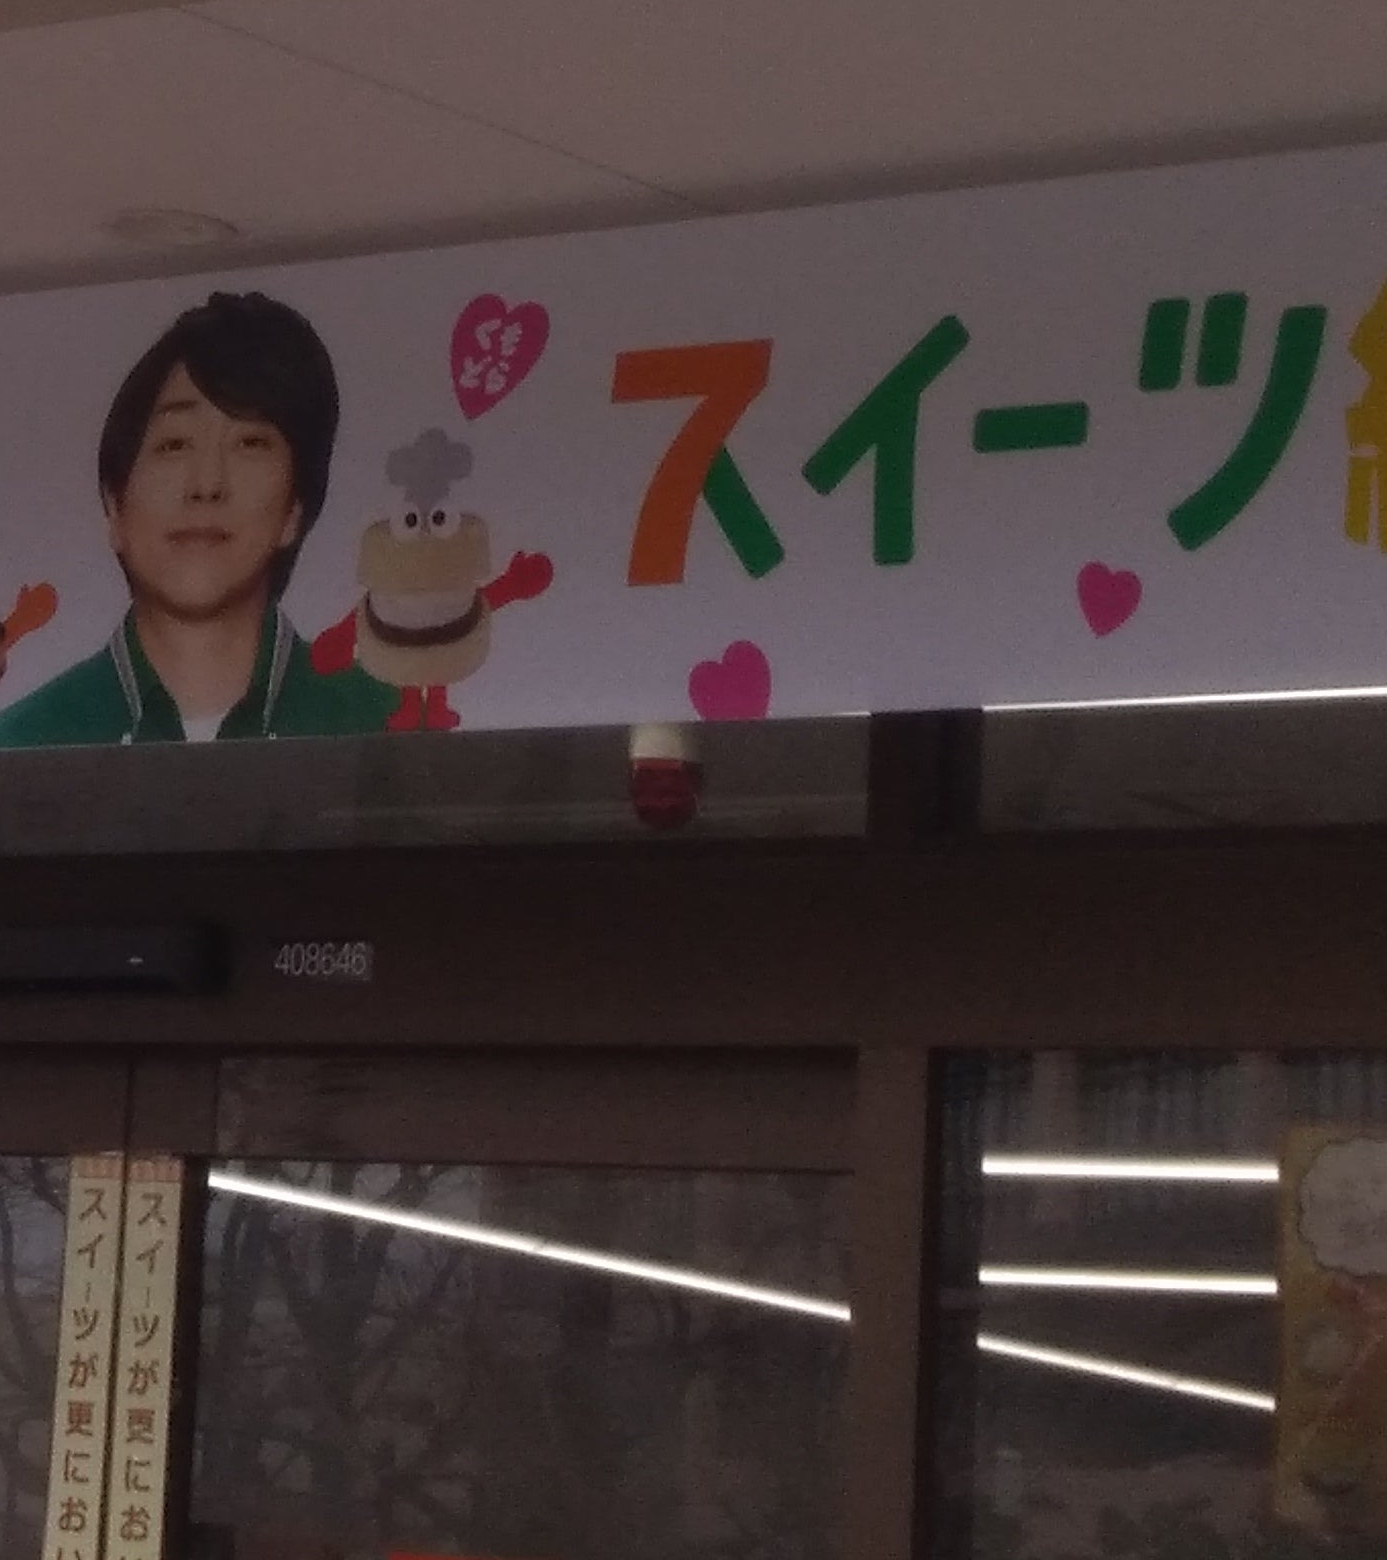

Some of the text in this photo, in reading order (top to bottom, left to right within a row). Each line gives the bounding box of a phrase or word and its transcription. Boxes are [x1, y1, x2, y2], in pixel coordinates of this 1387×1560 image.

[119, 1191, 168, 1559] スイーツが更にお
